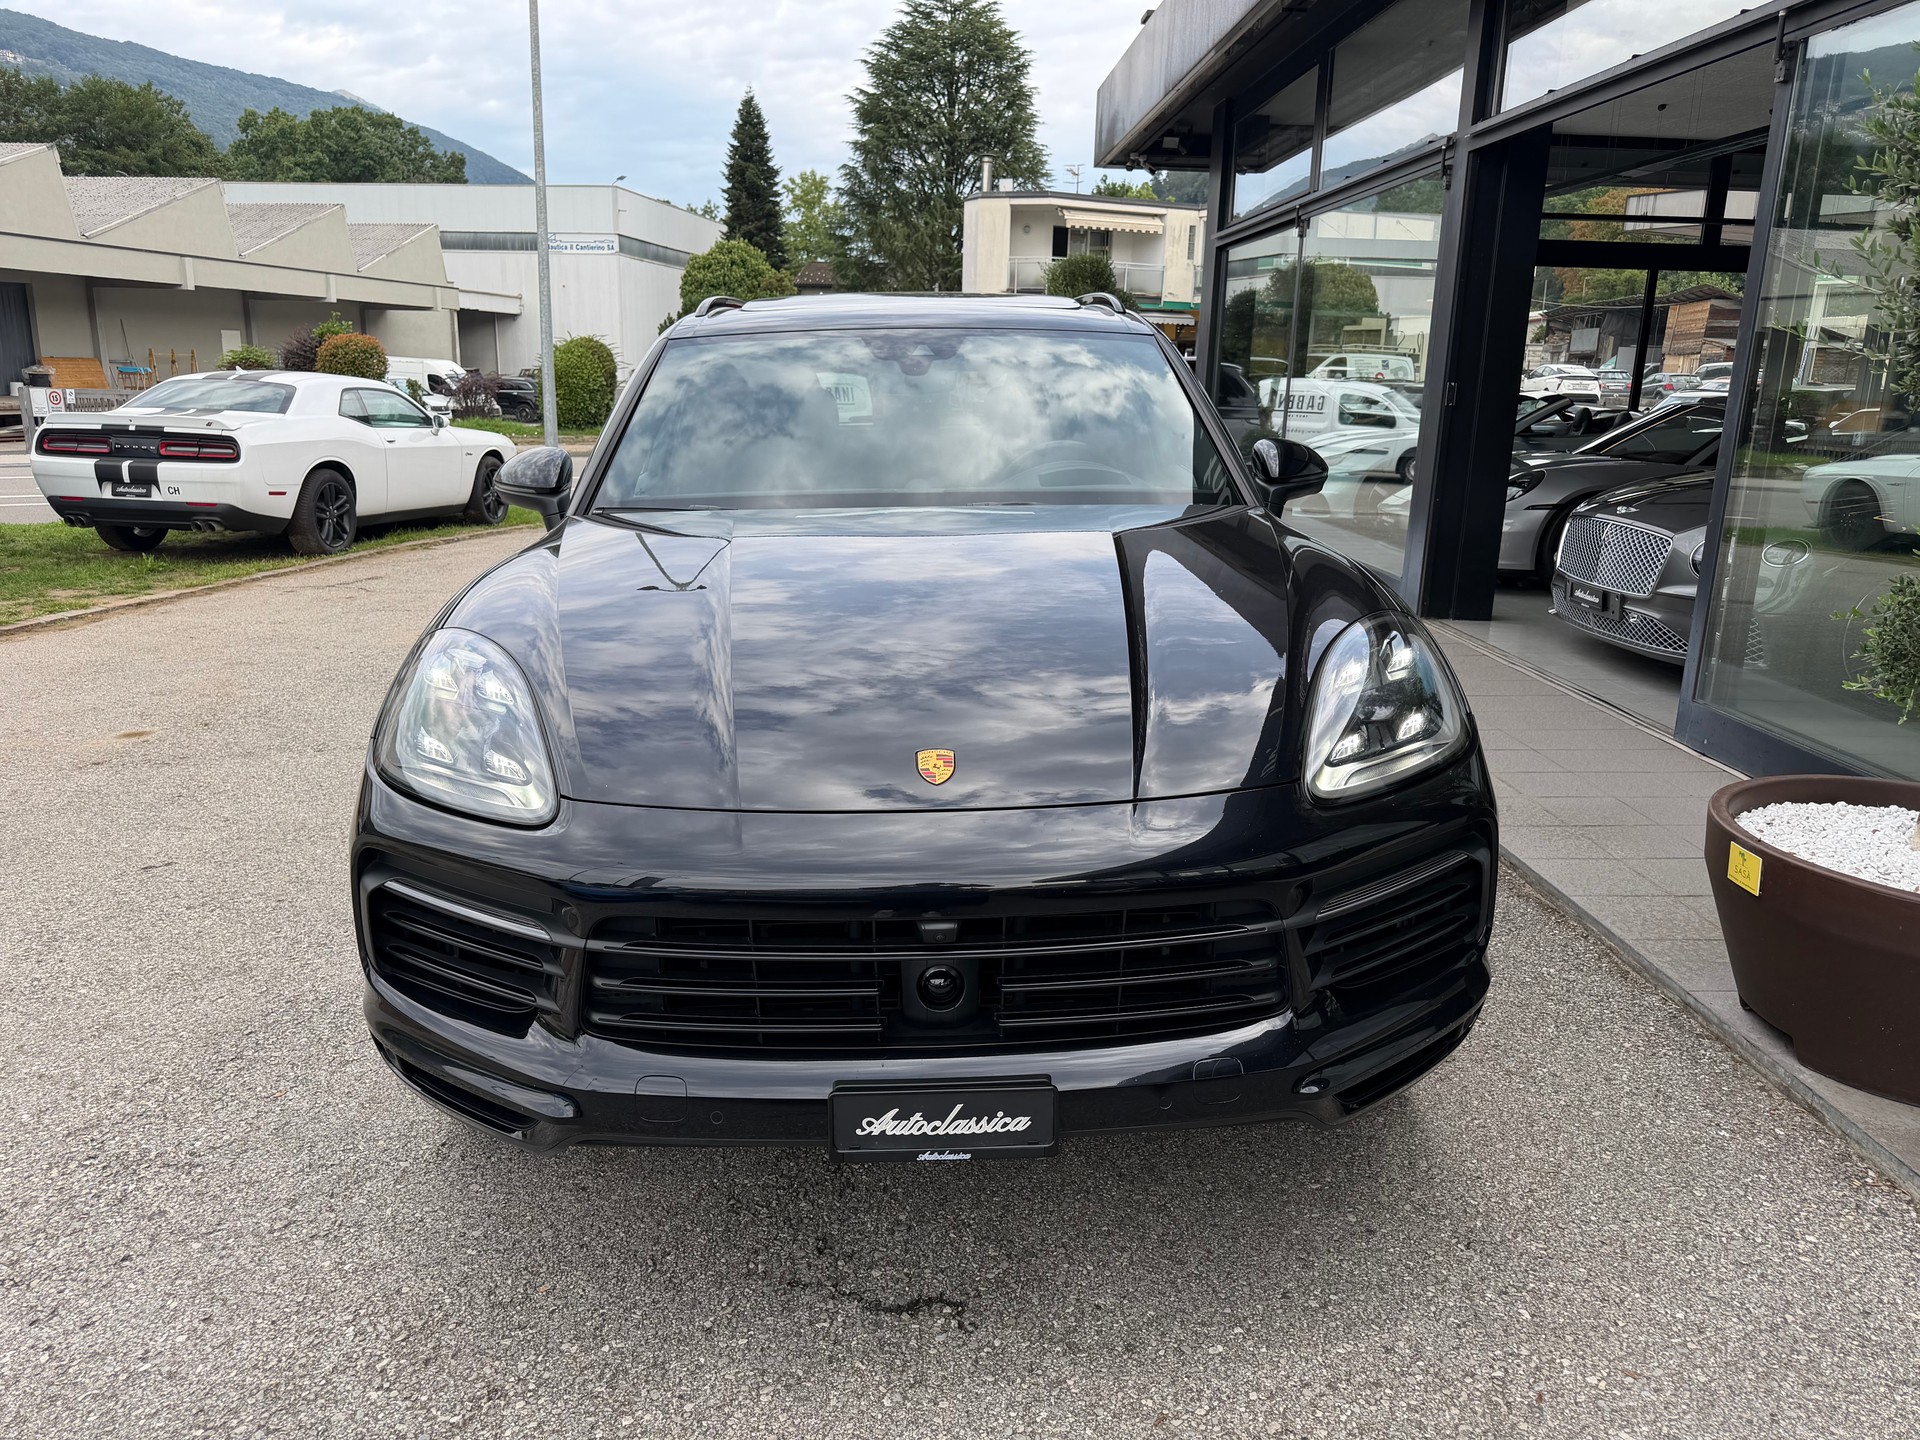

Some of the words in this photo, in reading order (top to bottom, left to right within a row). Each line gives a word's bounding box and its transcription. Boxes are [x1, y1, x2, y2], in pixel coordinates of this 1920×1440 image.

[51, 394, 59, 402] 15
[167, 486, 180, 495] CH
[856, 1103, 1032, 1136] Autoclassica
[916, 1150, 972, 1161] Autoclassica
